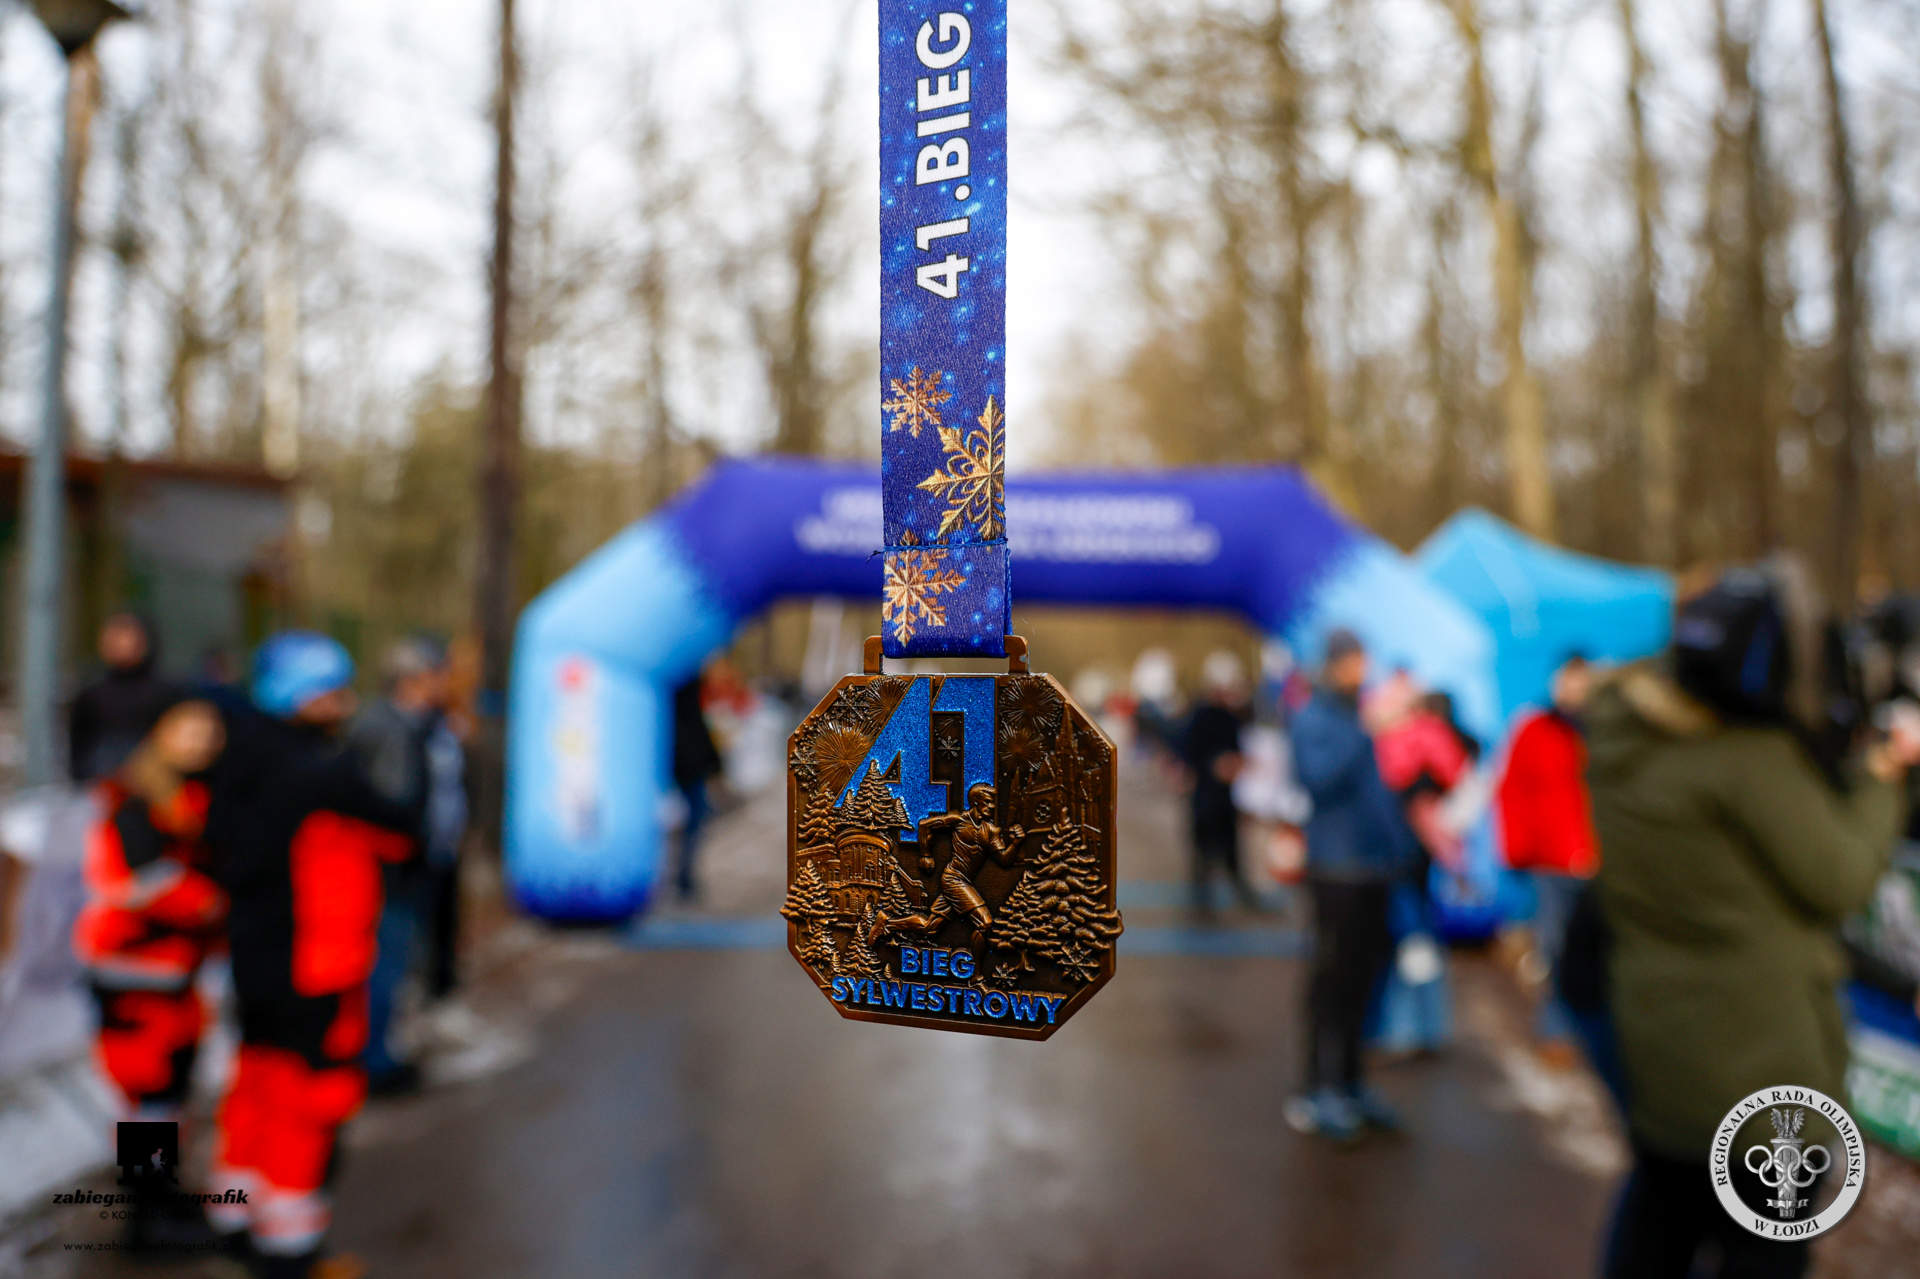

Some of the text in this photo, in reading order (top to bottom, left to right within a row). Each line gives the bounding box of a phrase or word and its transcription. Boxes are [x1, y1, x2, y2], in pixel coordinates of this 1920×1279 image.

[832, 675, 996, 842] 41
[900, 946, 976, 979] BIEG
[831, 975, 1064, 1024] SYLWESTROWY
